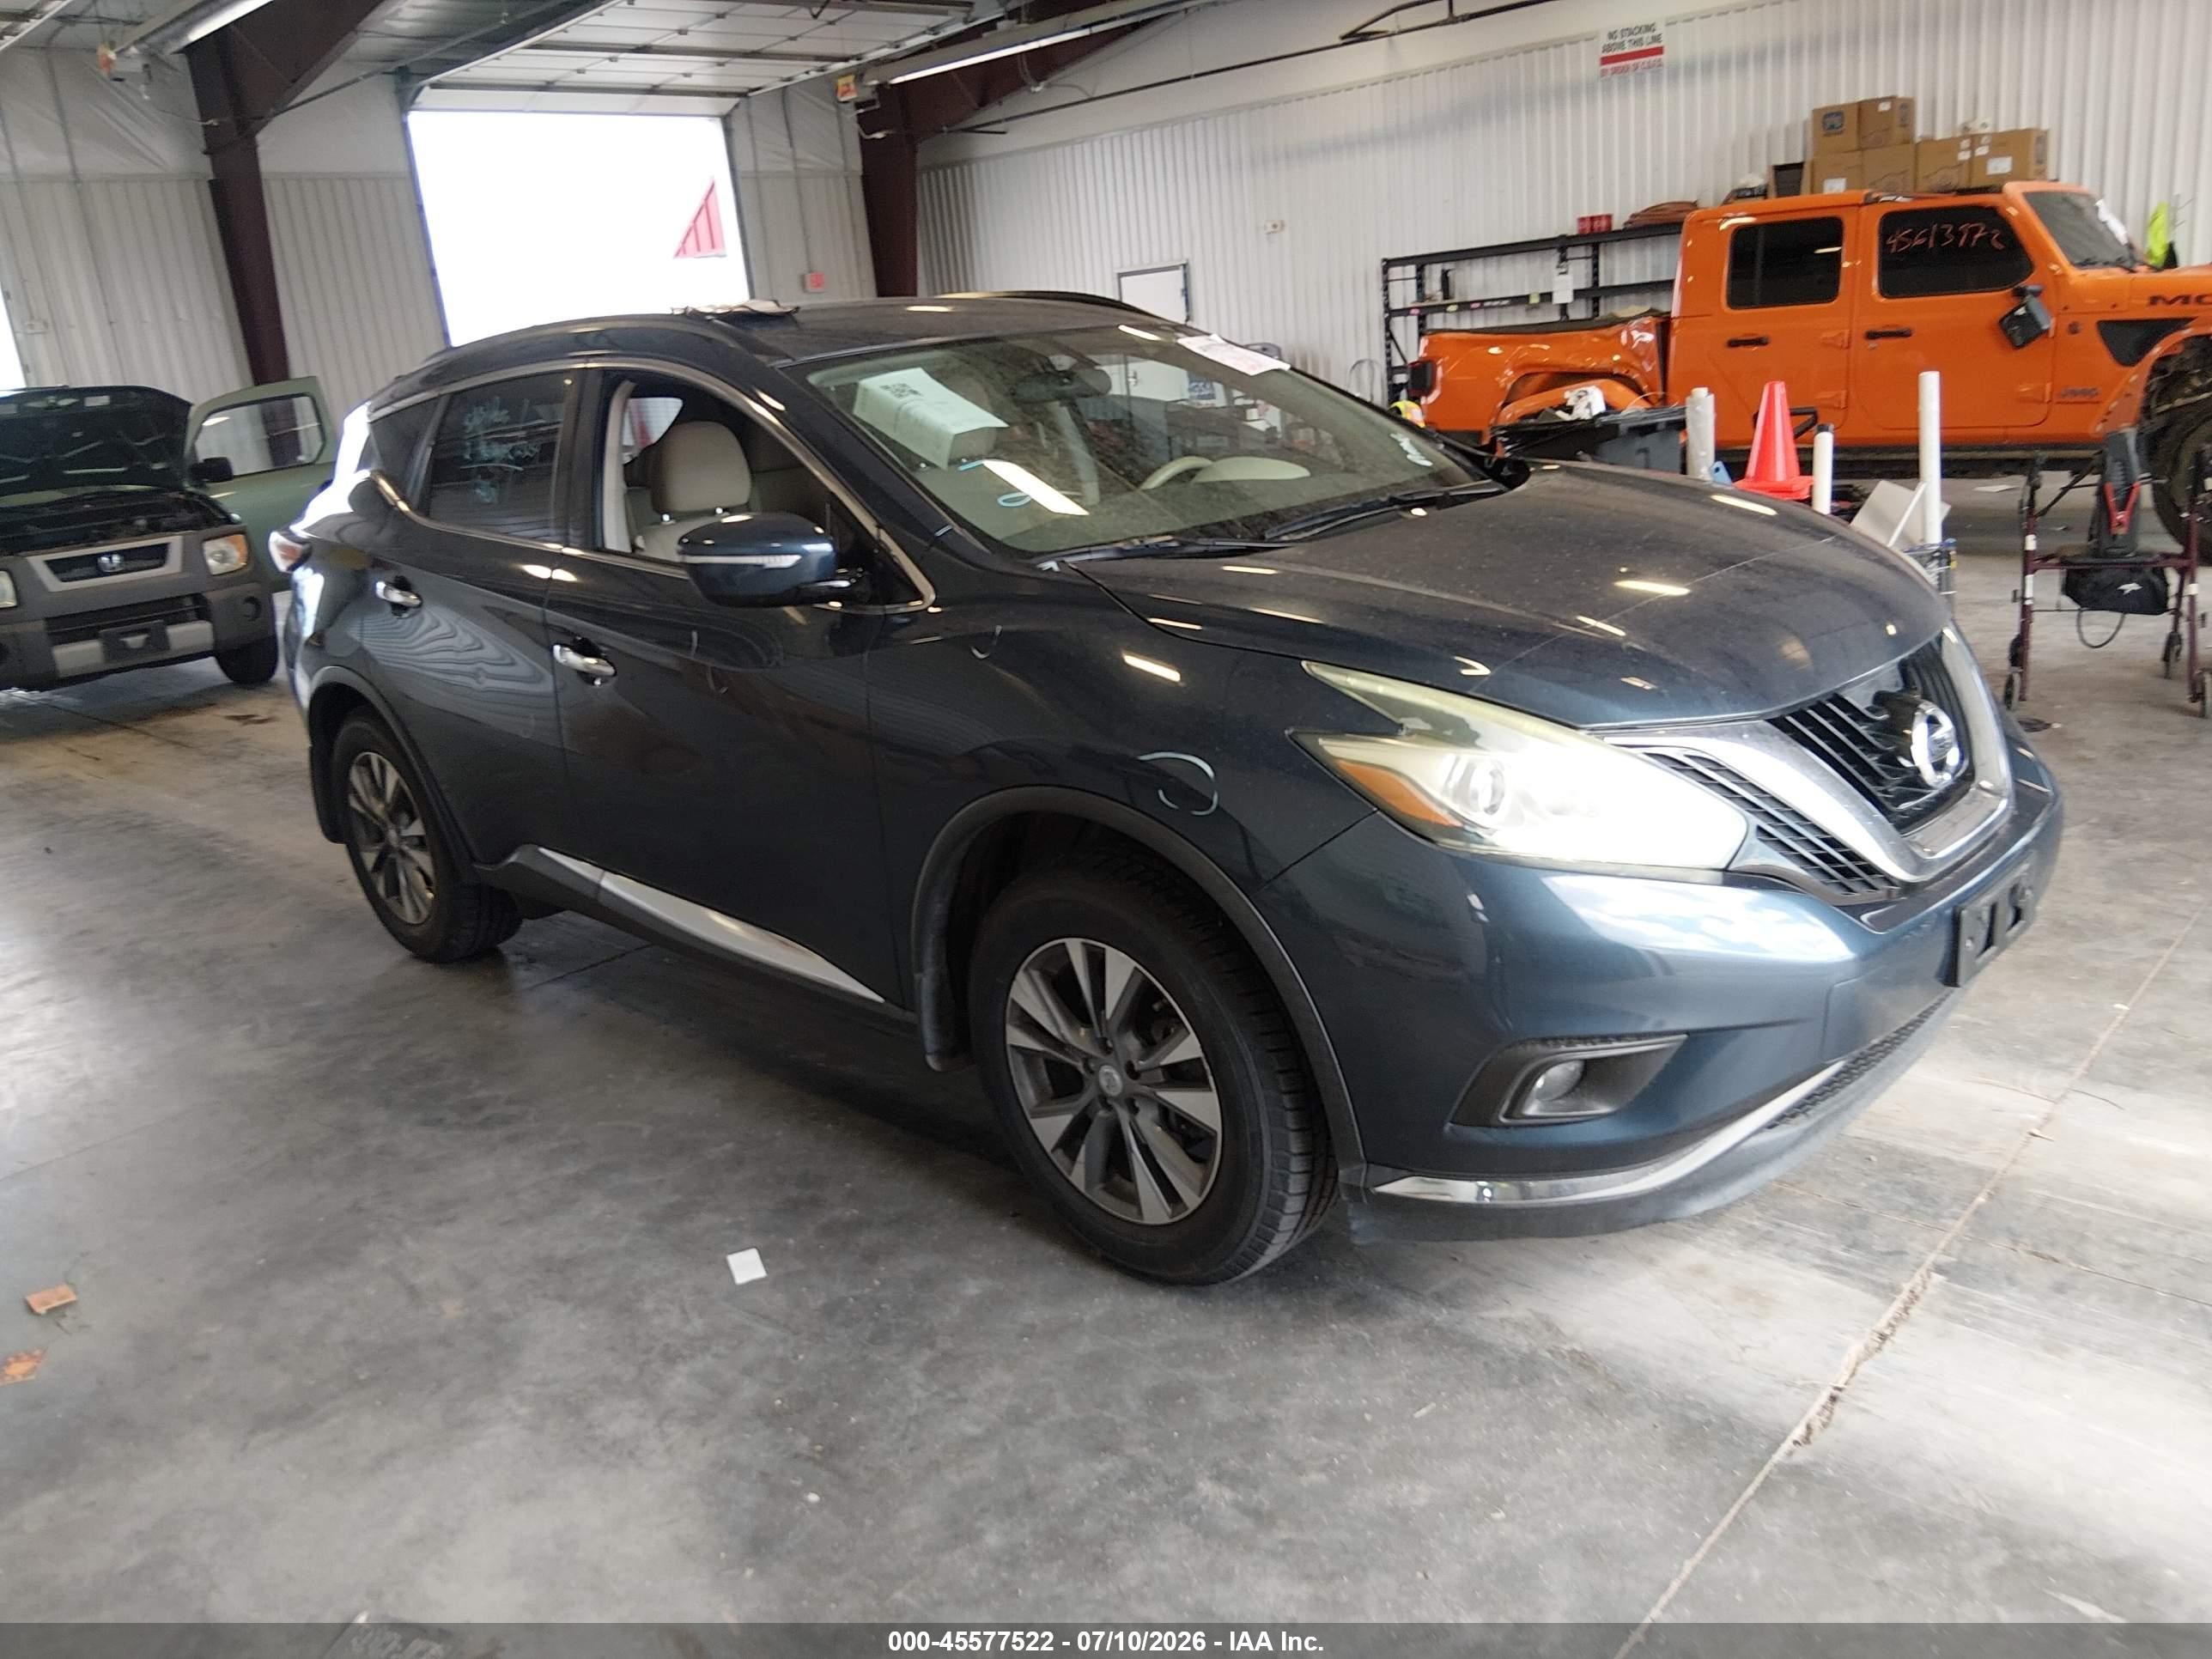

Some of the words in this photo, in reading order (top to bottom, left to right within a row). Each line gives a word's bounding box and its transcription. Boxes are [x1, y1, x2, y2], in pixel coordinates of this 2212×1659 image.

[1607, 29, 1618, 40] NO
[1620, 21, 1656, 39] STACKING
[1601, 40, 1626, 53] ABOVE
[1627, 36, 1644, 49] THIS
[1646, 33, 1663, 46] LINE
